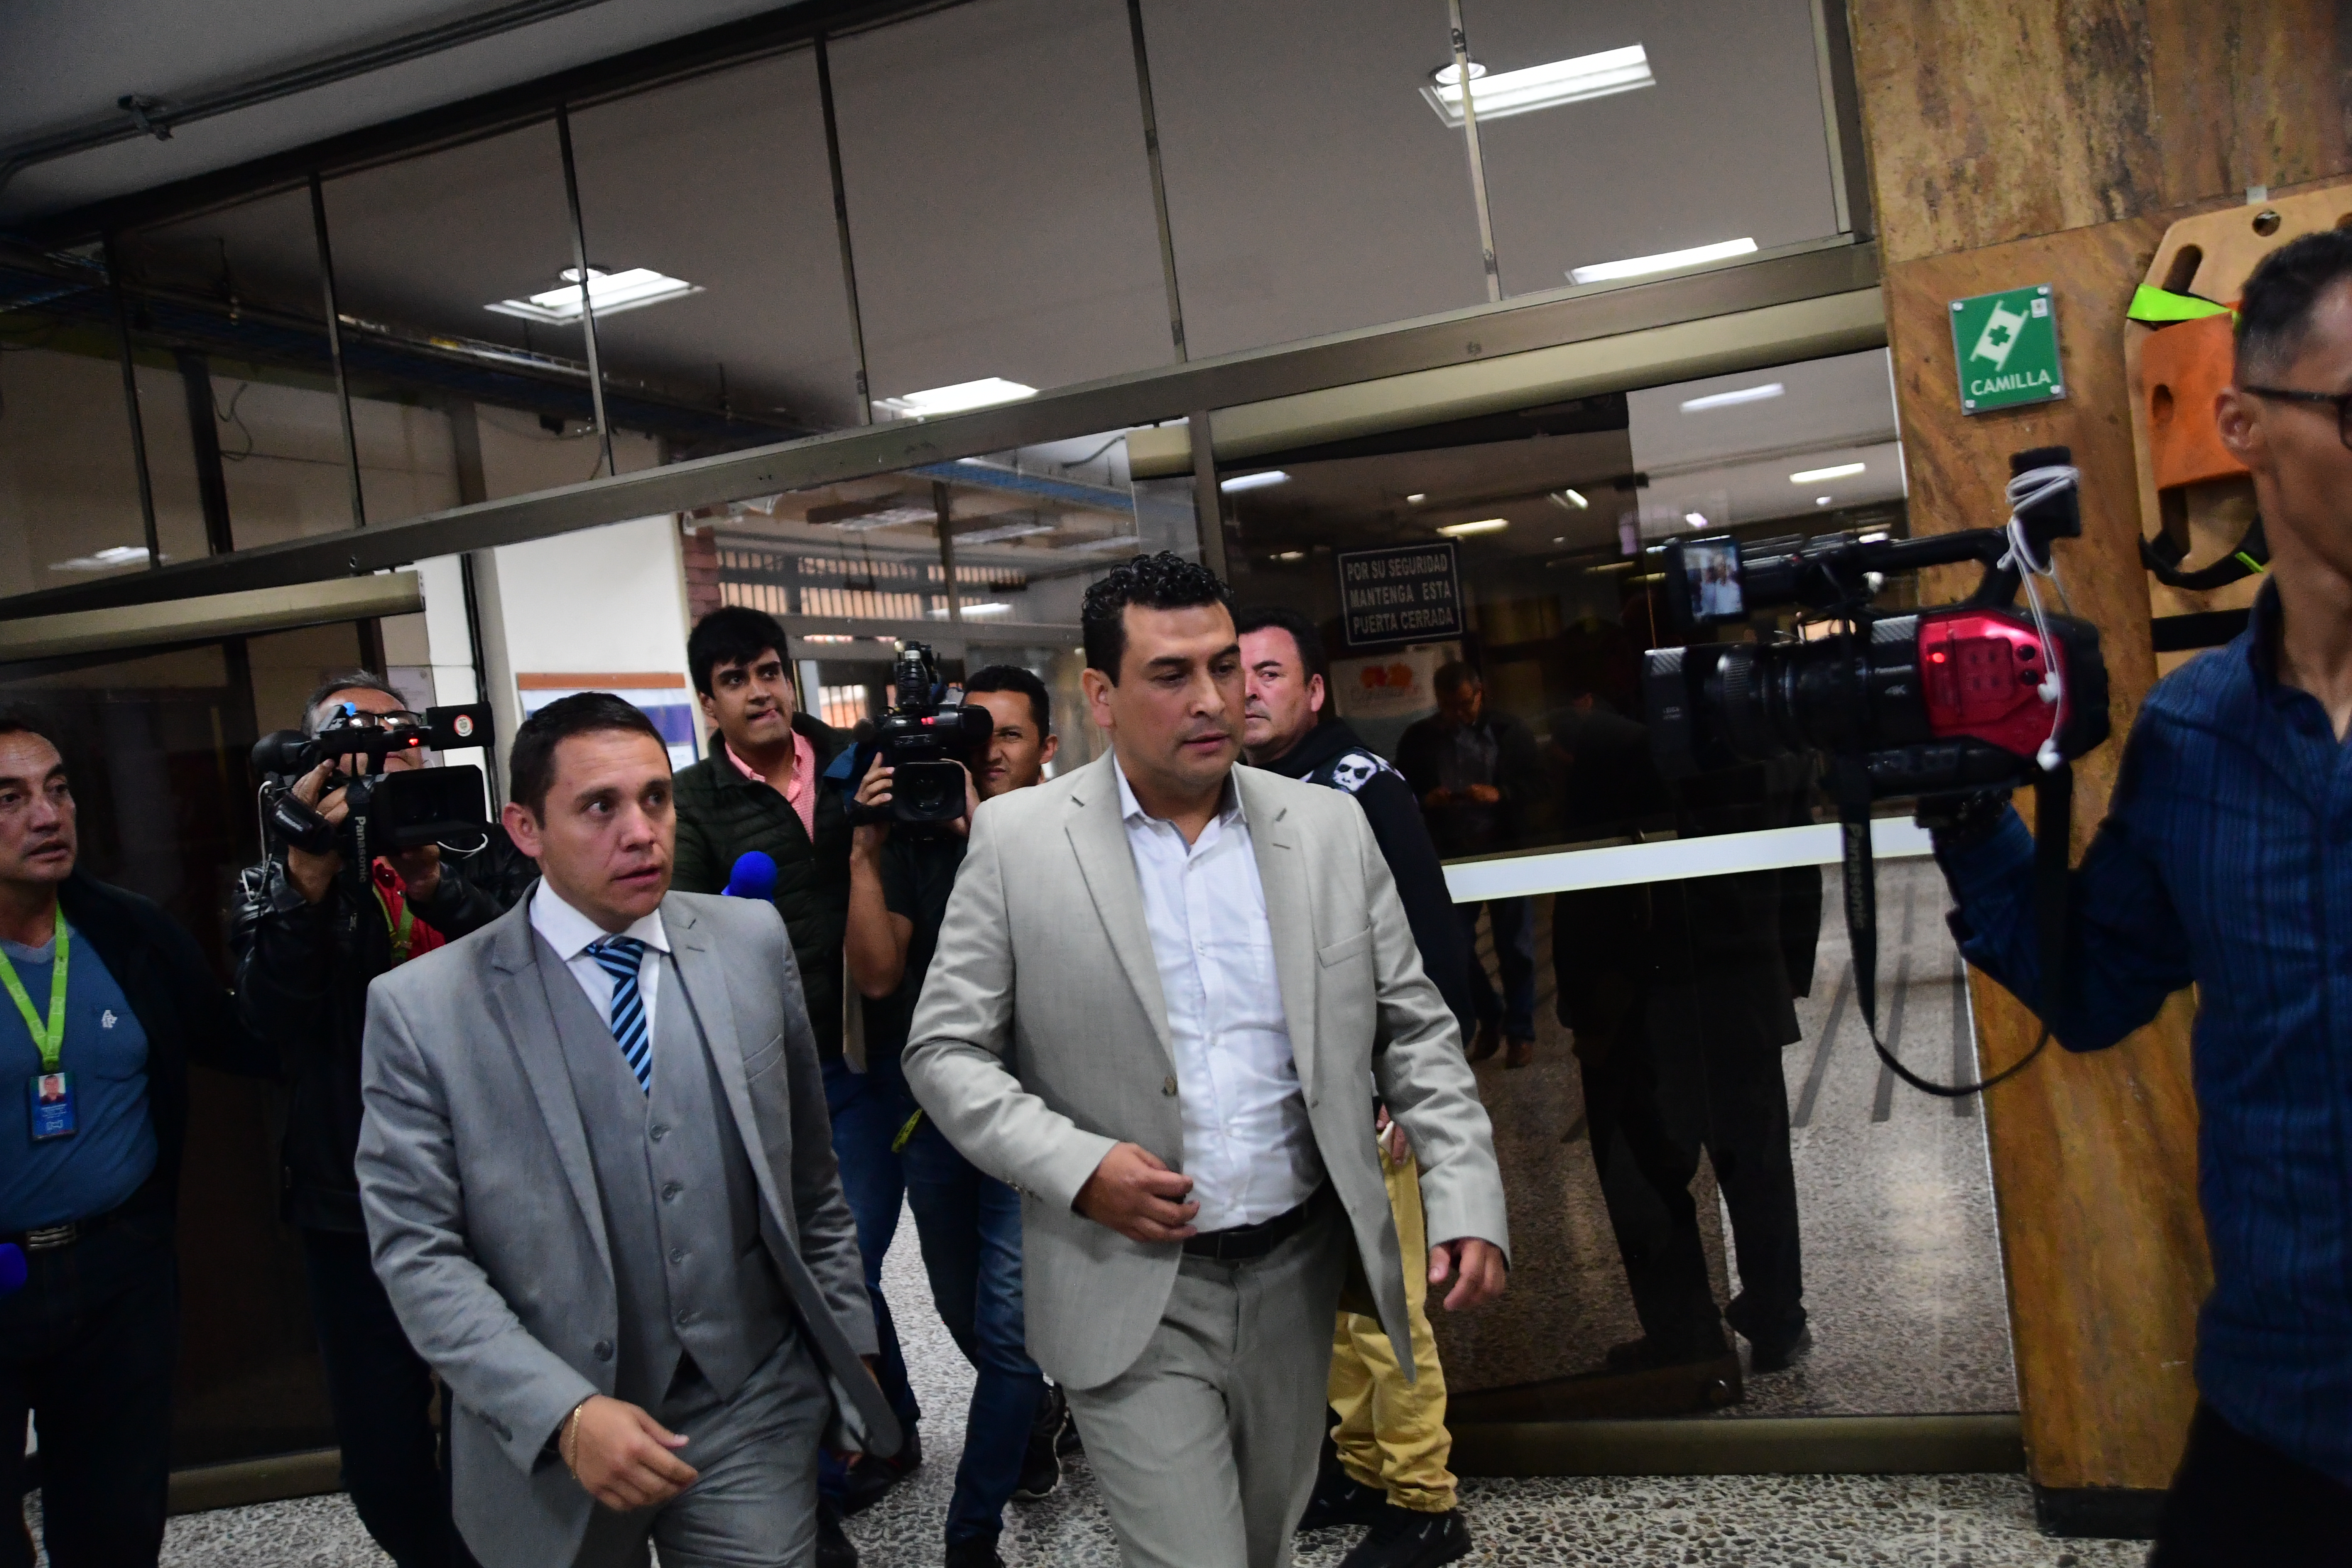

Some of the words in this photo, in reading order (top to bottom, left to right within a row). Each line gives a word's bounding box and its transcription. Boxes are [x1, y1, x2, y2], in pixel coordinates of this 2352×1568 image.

[1971, 369, 2052, 395] CAMILLA
[1347, 561, 1370, 581] POR
[1371, 559, 1386, 579] SU
[1387, 553, 1448, 578] SEGURIDAD
[1350, 584, 1415, 608] MANTENGA
[1421, 580, 1452, 600] ESTA
[1353, 612, 1399, 634] PUERTA
[1400, 607, 1454, 629] CERRADA
[354, 816, 369, 883] Panasonic
[1844, 823, 1868, 929] Panasonic
